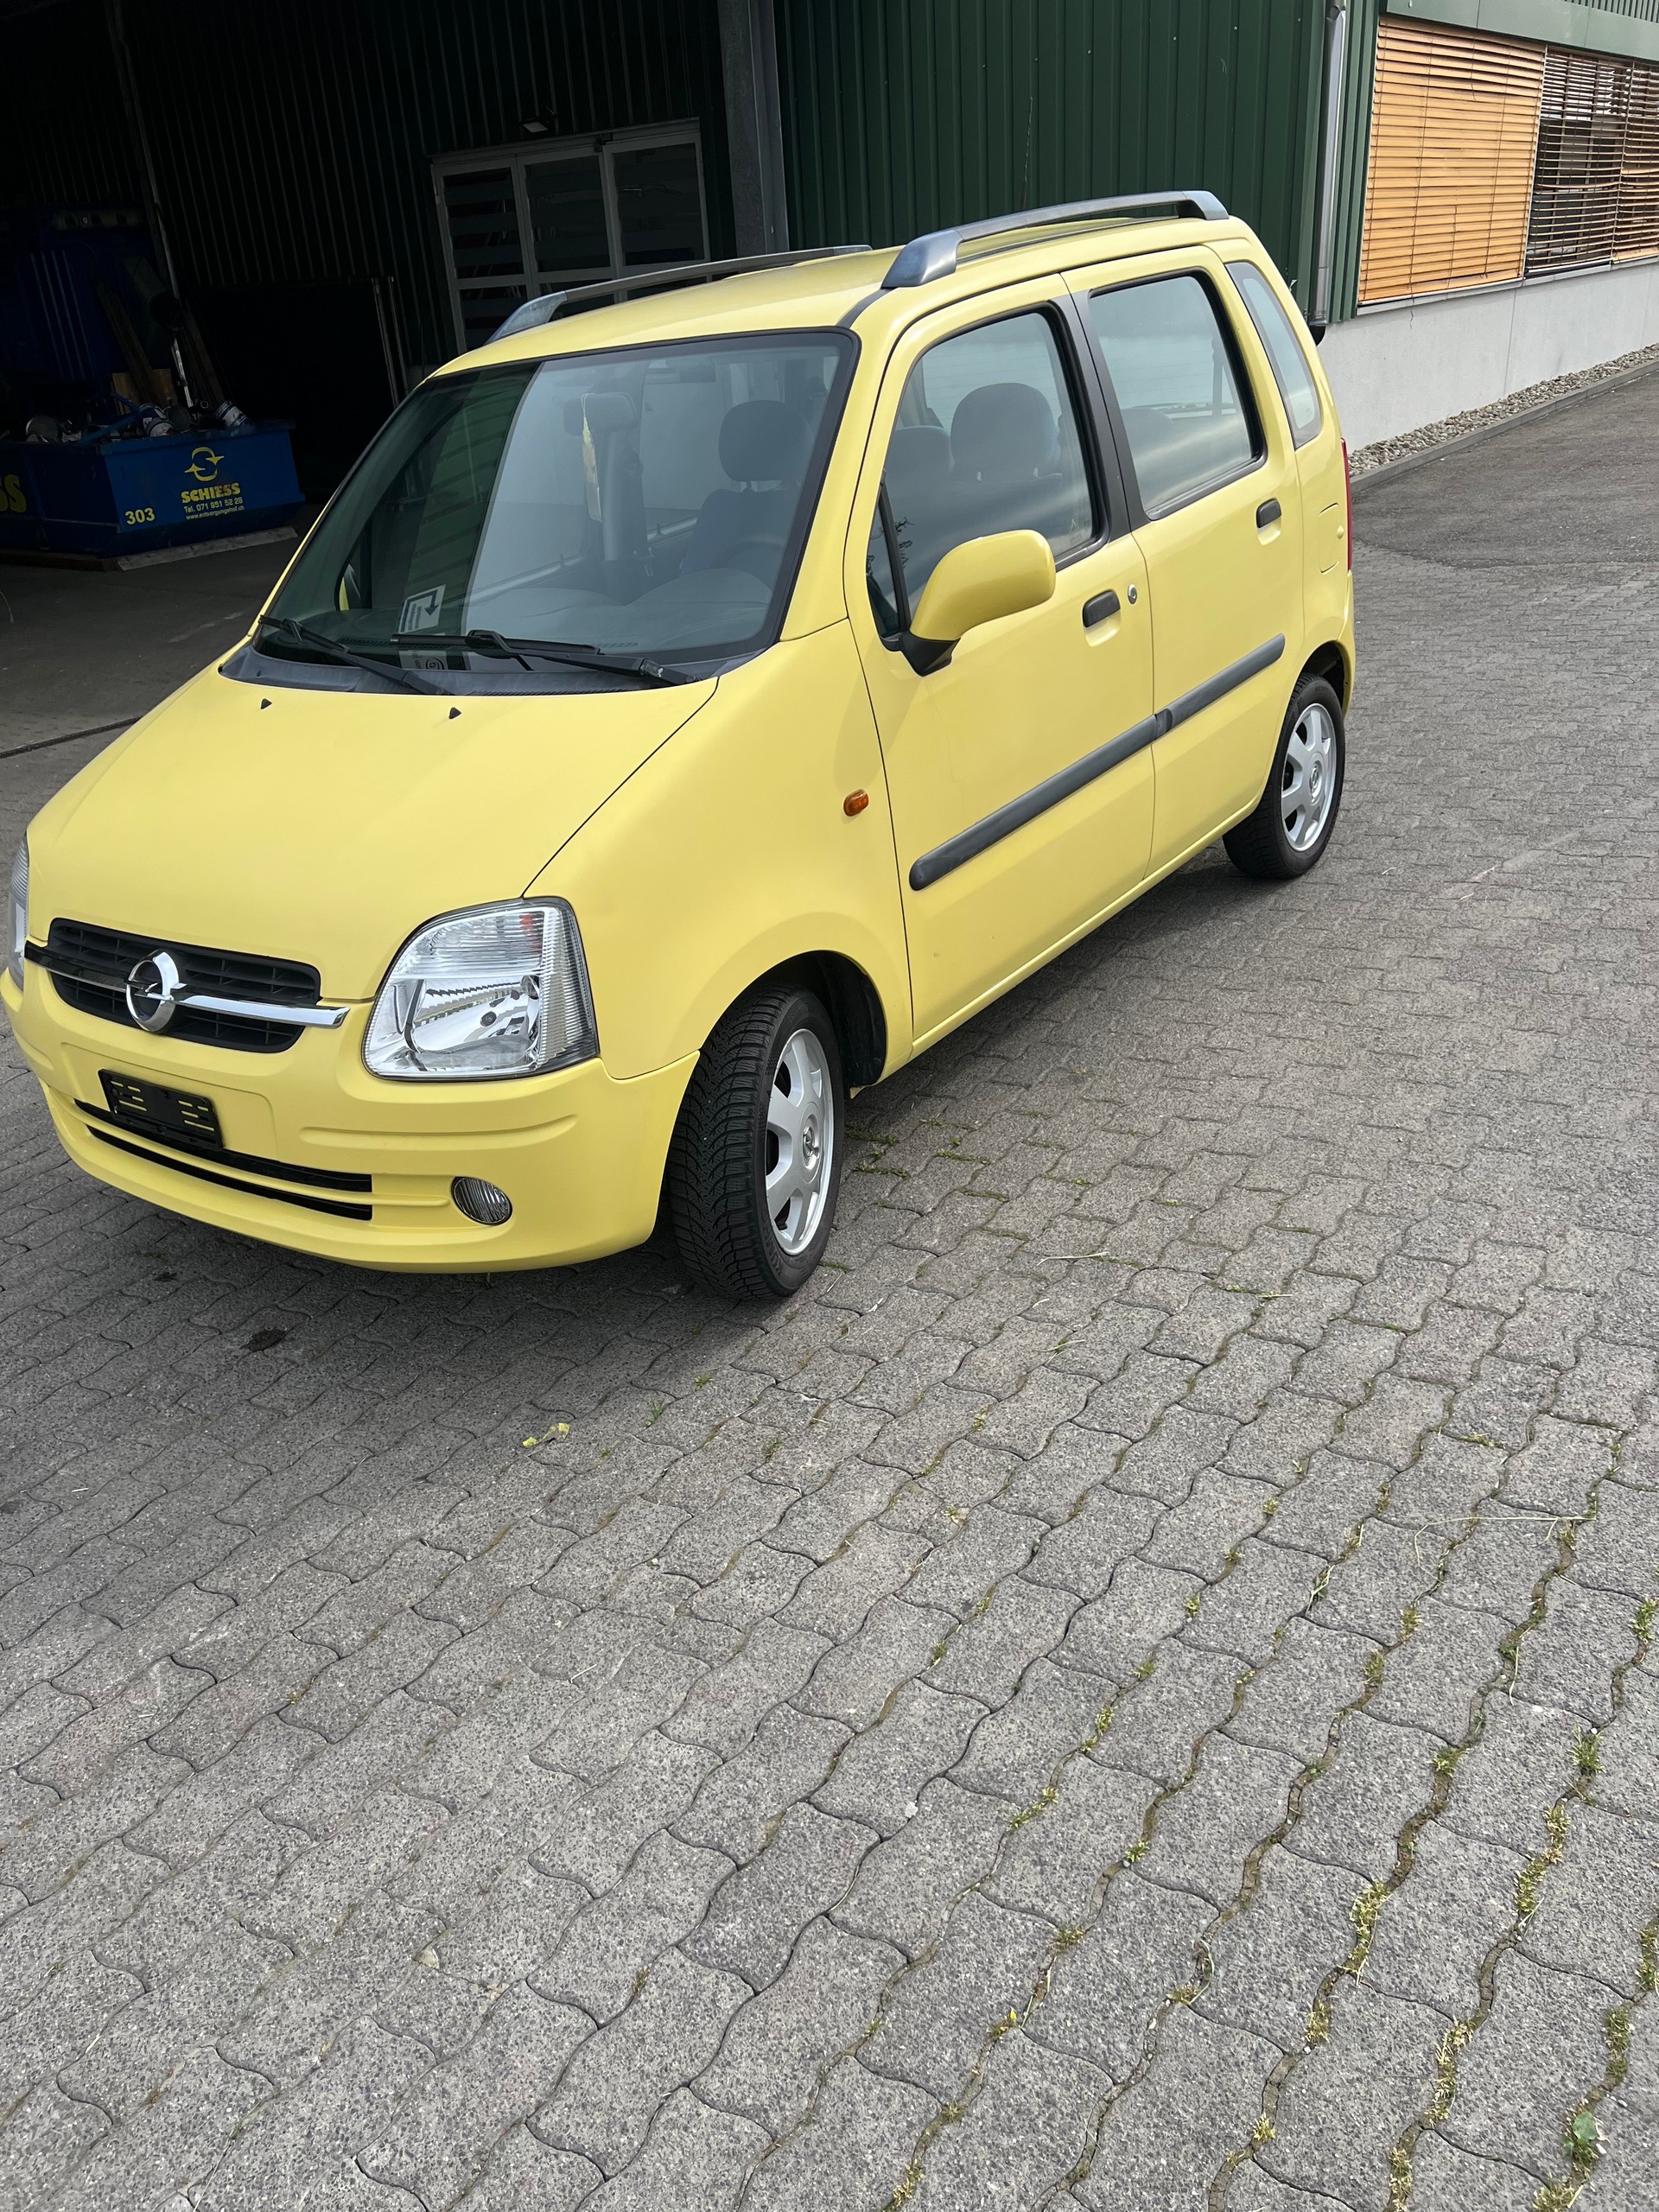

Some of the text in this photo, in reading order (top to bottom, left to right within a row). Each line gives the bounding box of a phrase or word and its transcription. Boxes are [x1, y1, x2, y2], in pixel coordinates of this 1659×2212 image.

[181, 483, 241, 504] SCHIESS
[124, 507, 156, 525] 303
[183, 505, 196, 514] Tel.
[196, 503, 209, 512] 071
